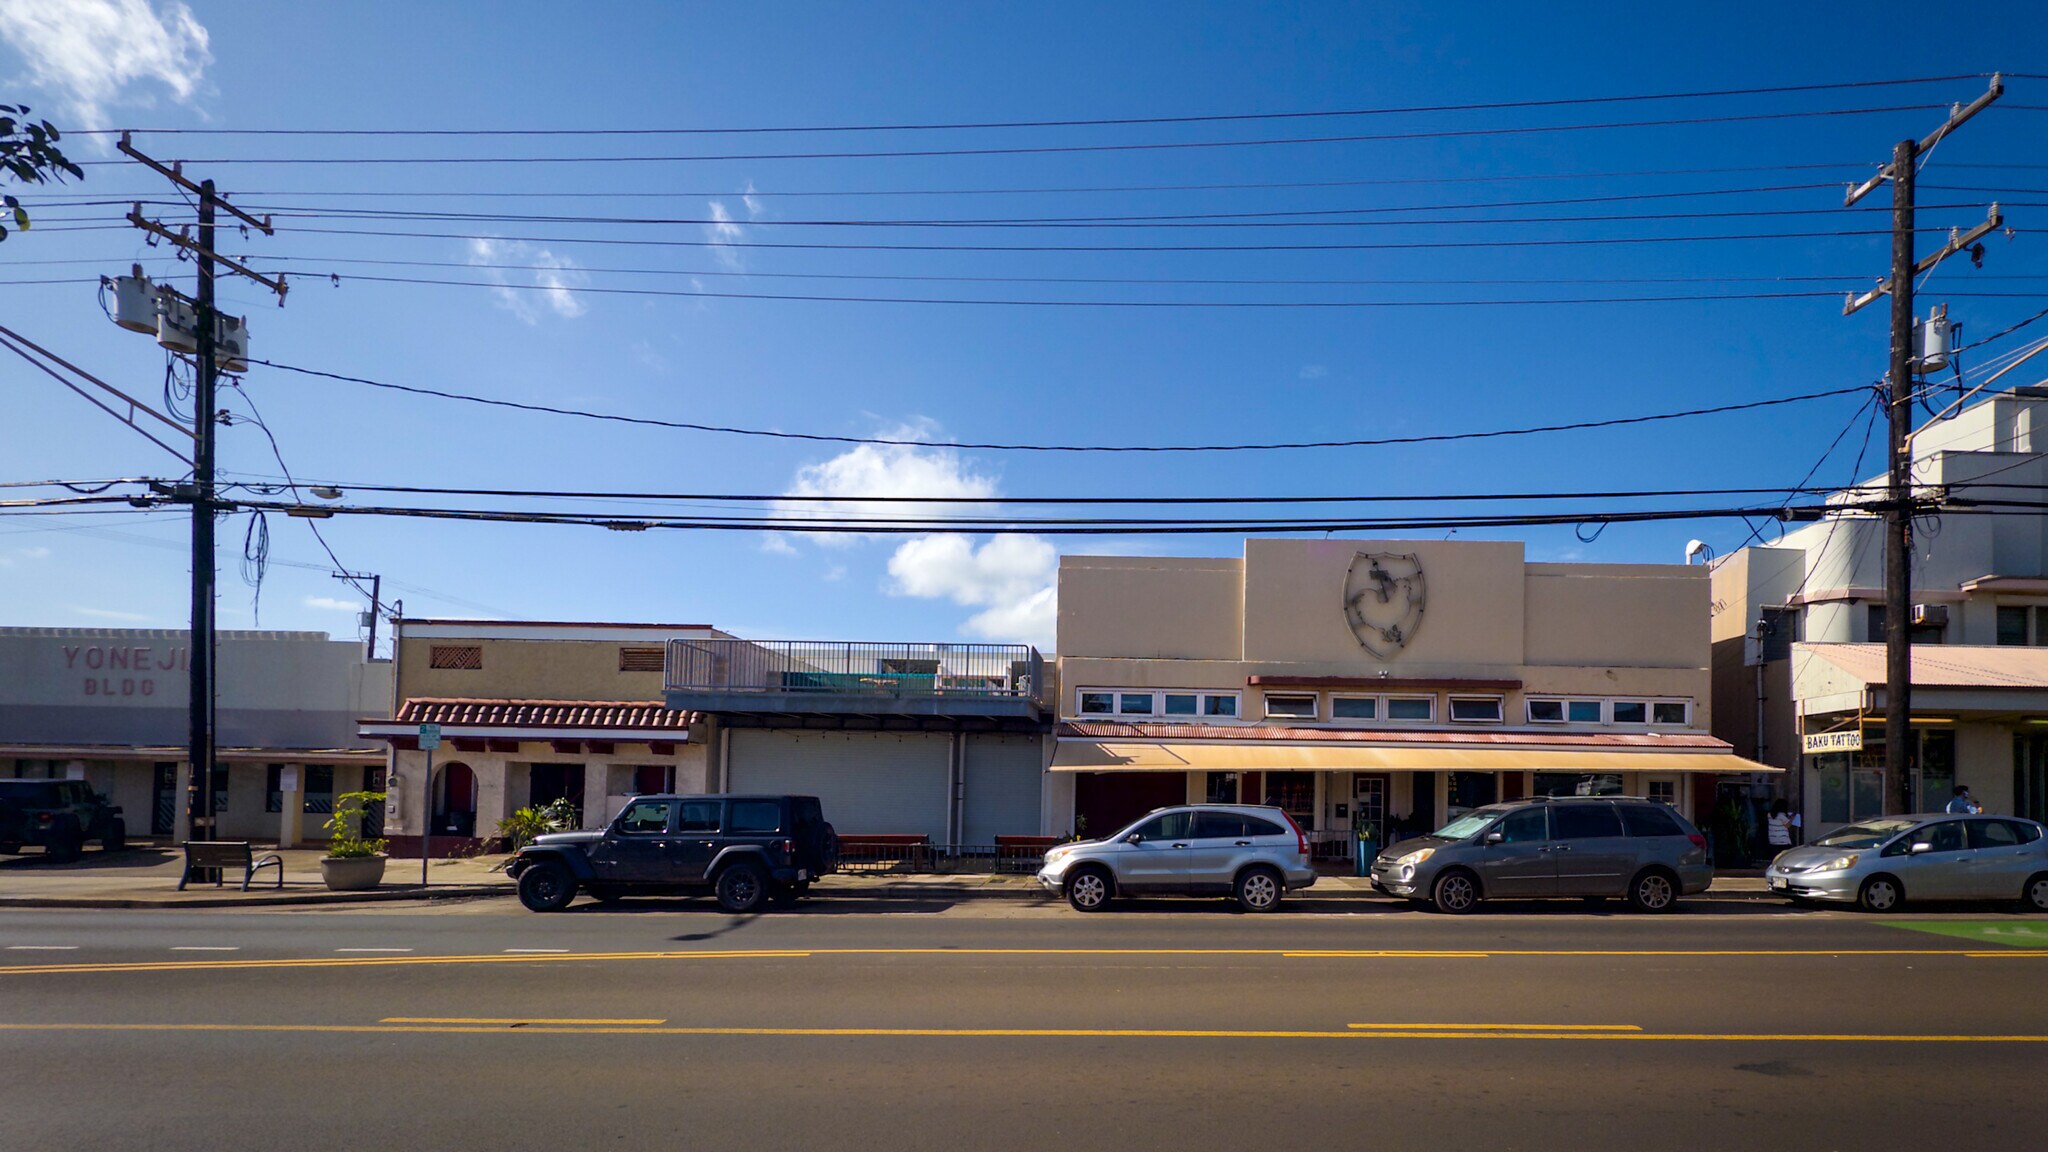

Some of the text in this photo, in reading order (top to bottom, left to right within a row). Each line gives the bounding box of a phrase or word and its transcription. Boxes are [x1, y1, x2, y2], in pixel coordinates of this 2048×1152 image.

[62, 646, 187, 671] YONEJI
[84, 678, 155, 696] BLDG
[1807, 733, 1860, 749] BAKU TATTOO
